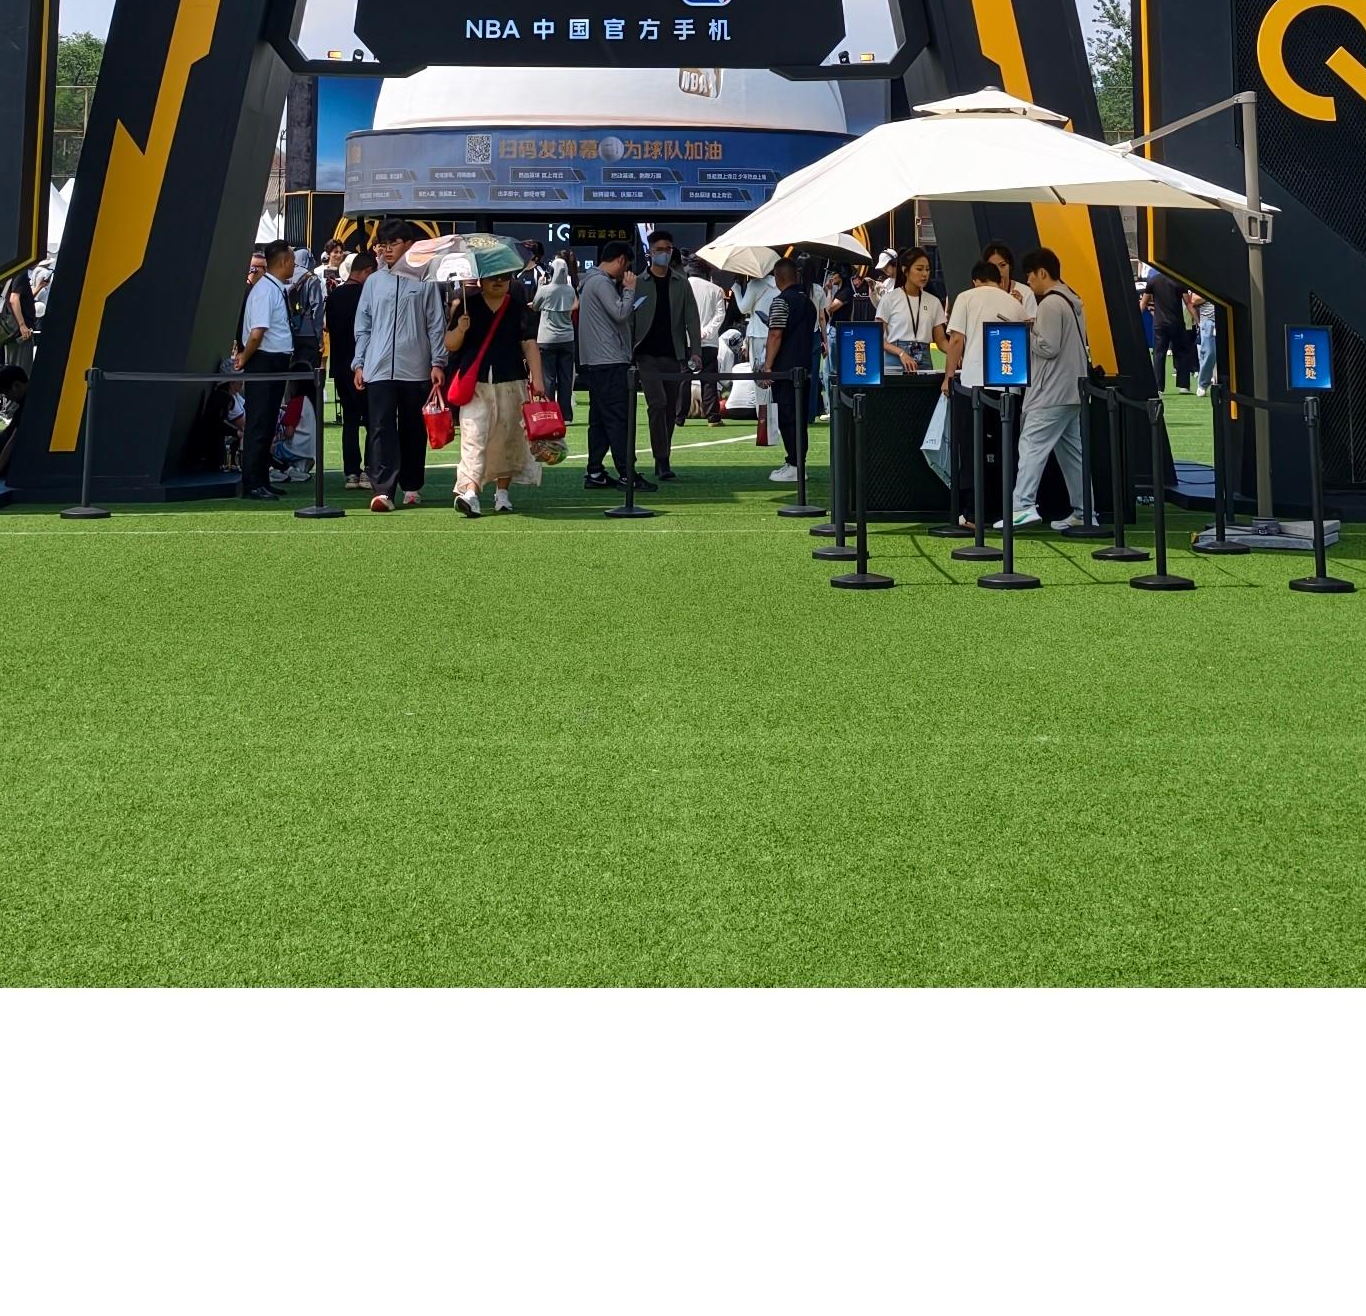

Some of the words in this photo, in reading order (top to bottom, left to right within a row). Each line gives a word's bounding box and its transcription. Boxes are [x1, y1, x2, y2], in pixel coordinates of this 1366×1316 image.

[466, 19, 520, 40] NBA
[534, 18, 732, 41] 中国官方手机
[623, 139, 723, 160] 为球队加油
